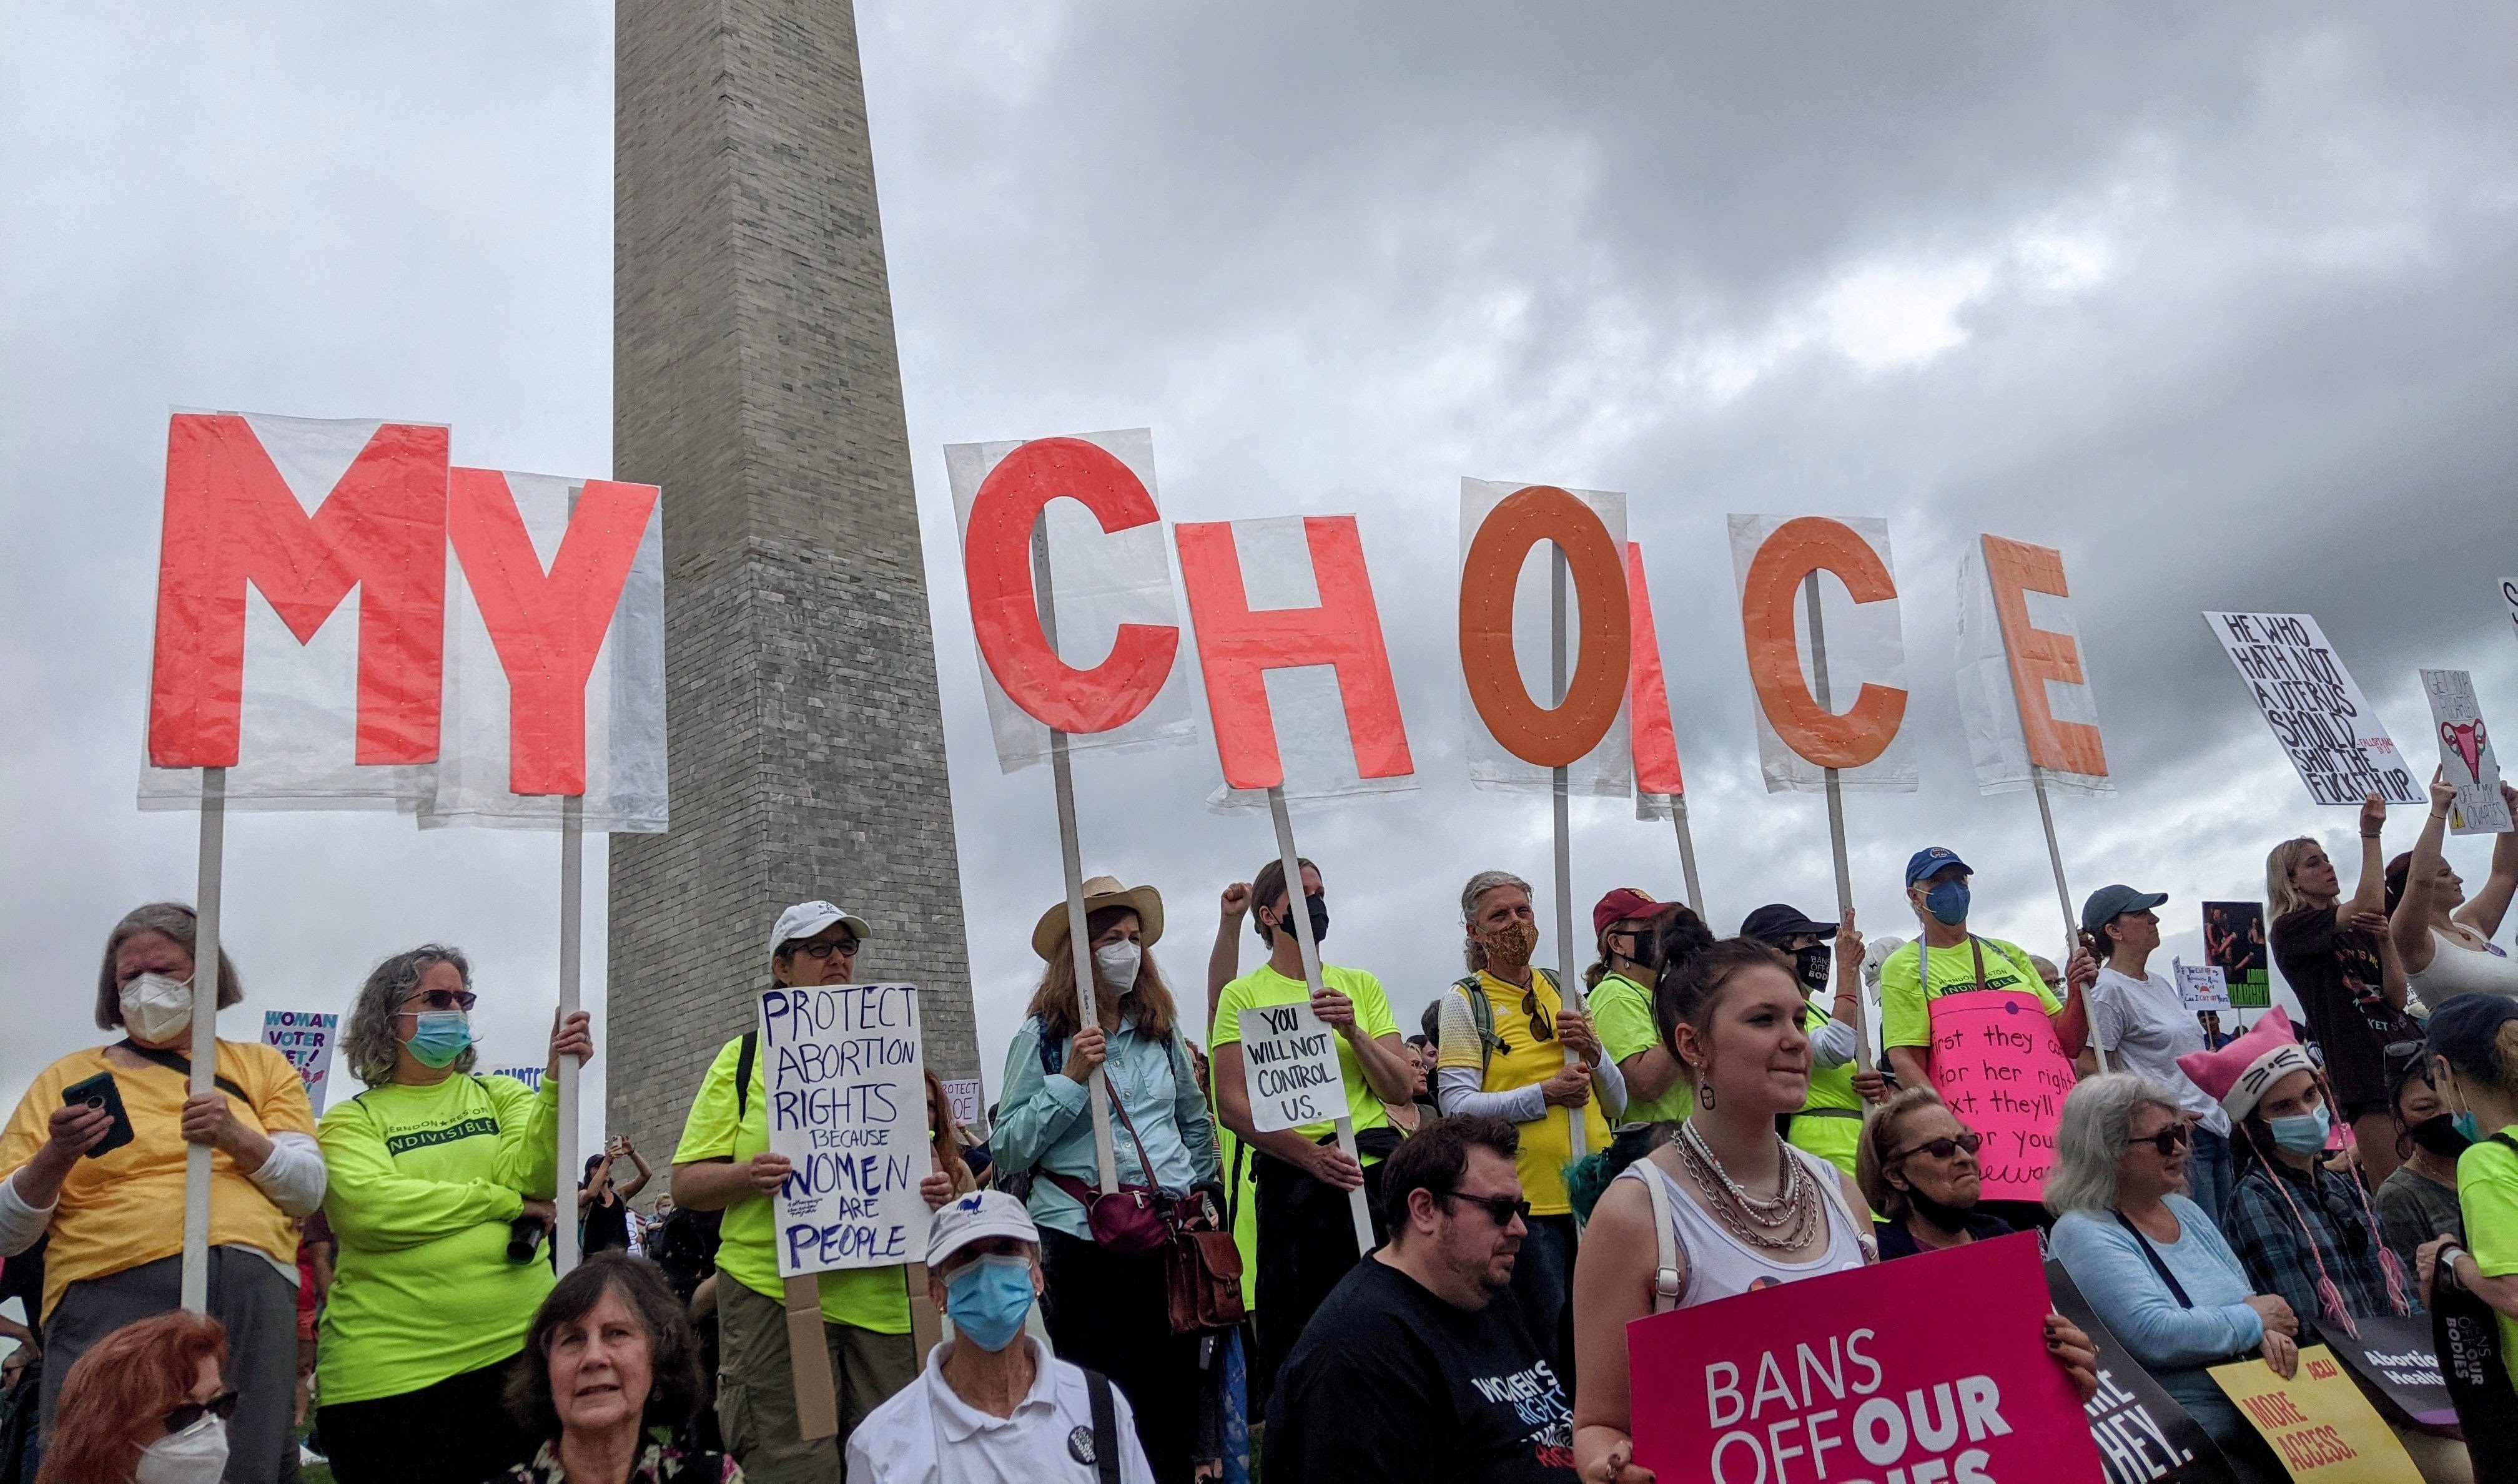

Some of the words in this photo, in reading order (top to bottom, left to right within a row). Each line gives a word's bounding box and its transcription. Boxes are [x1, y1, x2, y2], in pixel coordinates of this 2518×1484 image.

[2222, 614, 2261, 643] HE
[2252, 615, 2311, 647] WHO
[2231, 644, 2299, 681] HATH
[2289, 646, 2344, 685] NOT
[2253, 680, 2279, 709] A
[2270, 681, 2358, 717] UTERUS
[2426, 671, 2449, 695] GET
[2268, 710, 2356, 749] SHOULD
[2291, 748, 2341, 774] SHUT
[2334, 747, 2379, 776] THE
[2458, 785, 2474, 803] OFF
[2481, 783, 2494, 804] MY
[2467, 802, 2507, 829] OVARIES
[265, 1011, 337, 1029] WOMAN
[763, 986, 916, 1048] PROTECT
[1260, 1007, 1298, 1035] YOU
[269, 1031, 325, 1048] VOTER
[1247, 1039, 1291, 1065] WILL
[1289, 1033, 1327, 1060] NOT
[1983, 1025, 2033, 1054] they
[776, 1036, 914, 1090] ABORTION
[1939, 1065, 1969, 1088] for
[1982, 1059, 2022, 1082] her
[2038, 1069, 2077, 1095] right
[942, 1082, 979, 1094] ROTECT
[1258, 1062, 1338, 1098] CONTROL
[773, 1083, 897, 1131] RIGHTS
[952, 1096, 973, 1120] OE
[1280, 1094, 1323, 1122] US.
[1990, 1089, 2054, 1121] they'll
[809, 1129, 891, 1149] BECAUSE
[781, 1152, 910, 1200] WOMEN
[839, 1195, 880, 1221] ARE
[786, 1223, 907, 1270] PEOPLE
[2363, 1349, 2439, 1367] Abortio
[2446, 1317, 2469, 1378] BODIES
[1706, 1327, 1882, 1429] BANS
[2466, 1348, 2484, 1385] OUR
[2241, 1391, 2309, 1430] MORE
[1711, 1408, 1842, 1484] OFF
[1852, 1374, 2013, 1467] OUR
[2276, 1425, 2358, 1472] ACCESS.
